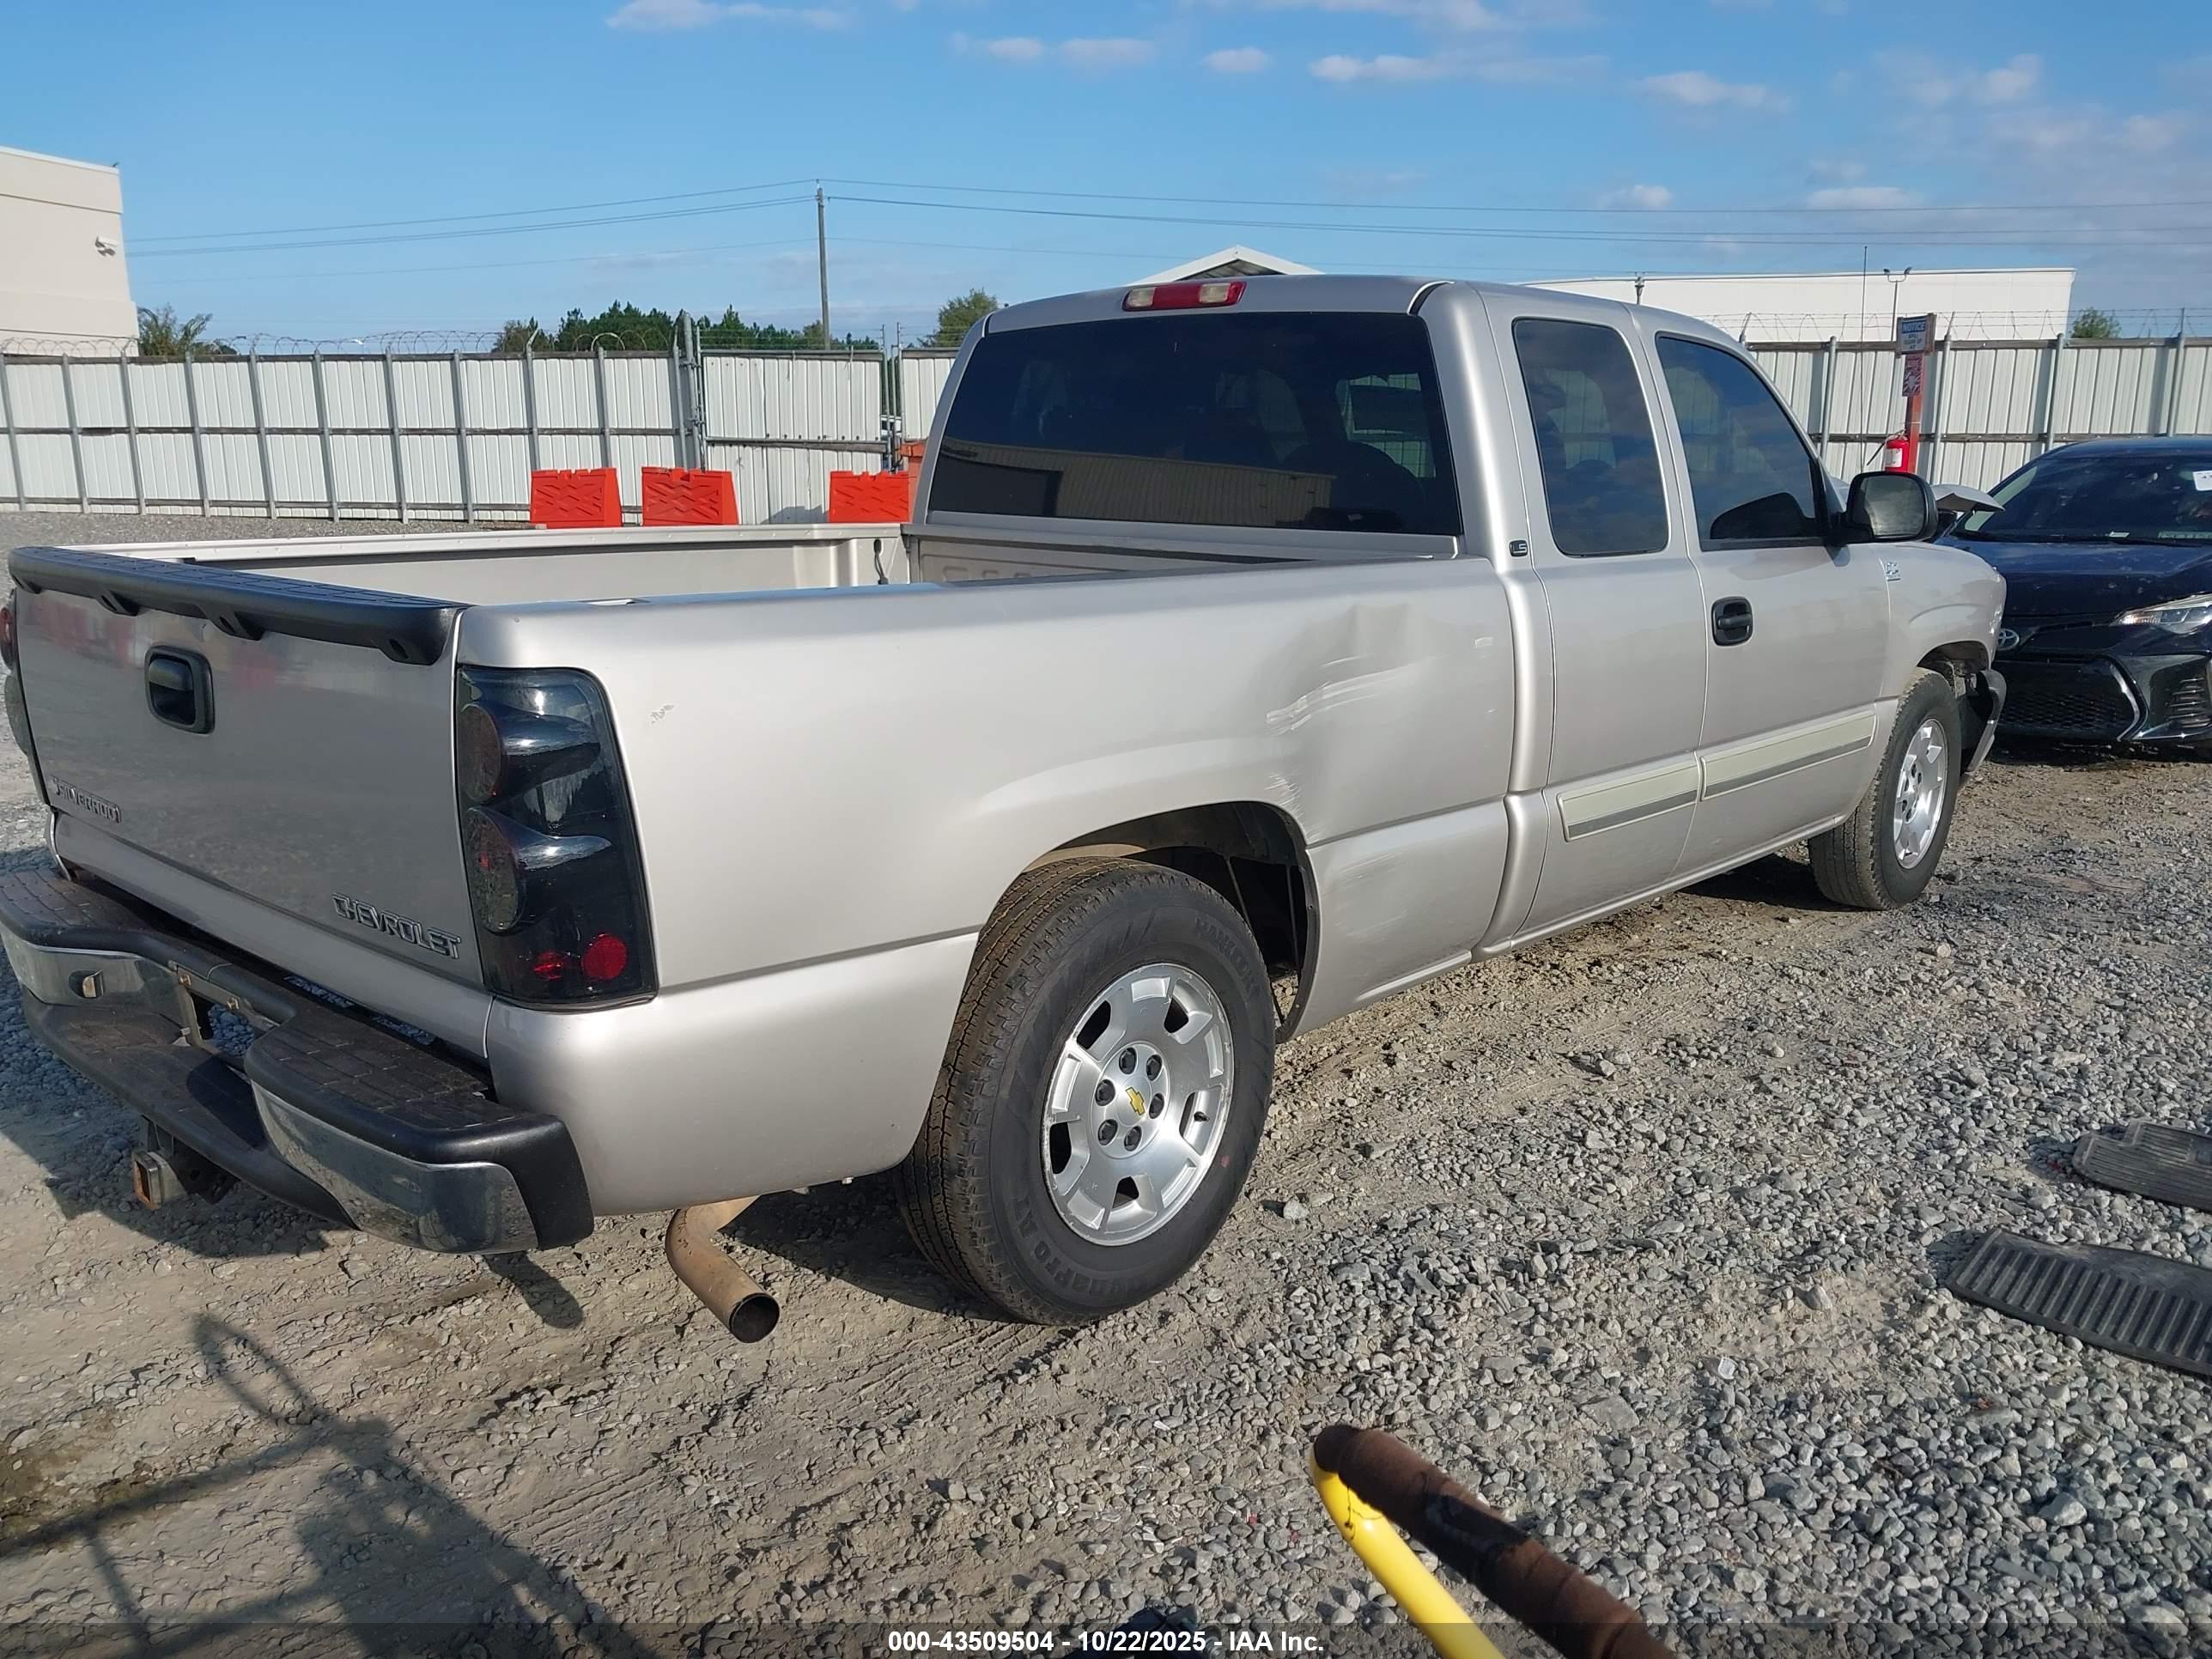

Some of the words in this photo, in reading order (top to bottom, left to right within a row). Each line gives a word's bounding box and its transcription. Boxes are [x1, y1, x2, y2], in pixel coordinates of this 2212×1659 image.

[1903, 321, 1926, 332] NOTICE
[1512, 543, 1528, 555] LS
[331, 892, 462, 960] CHEVROLET
